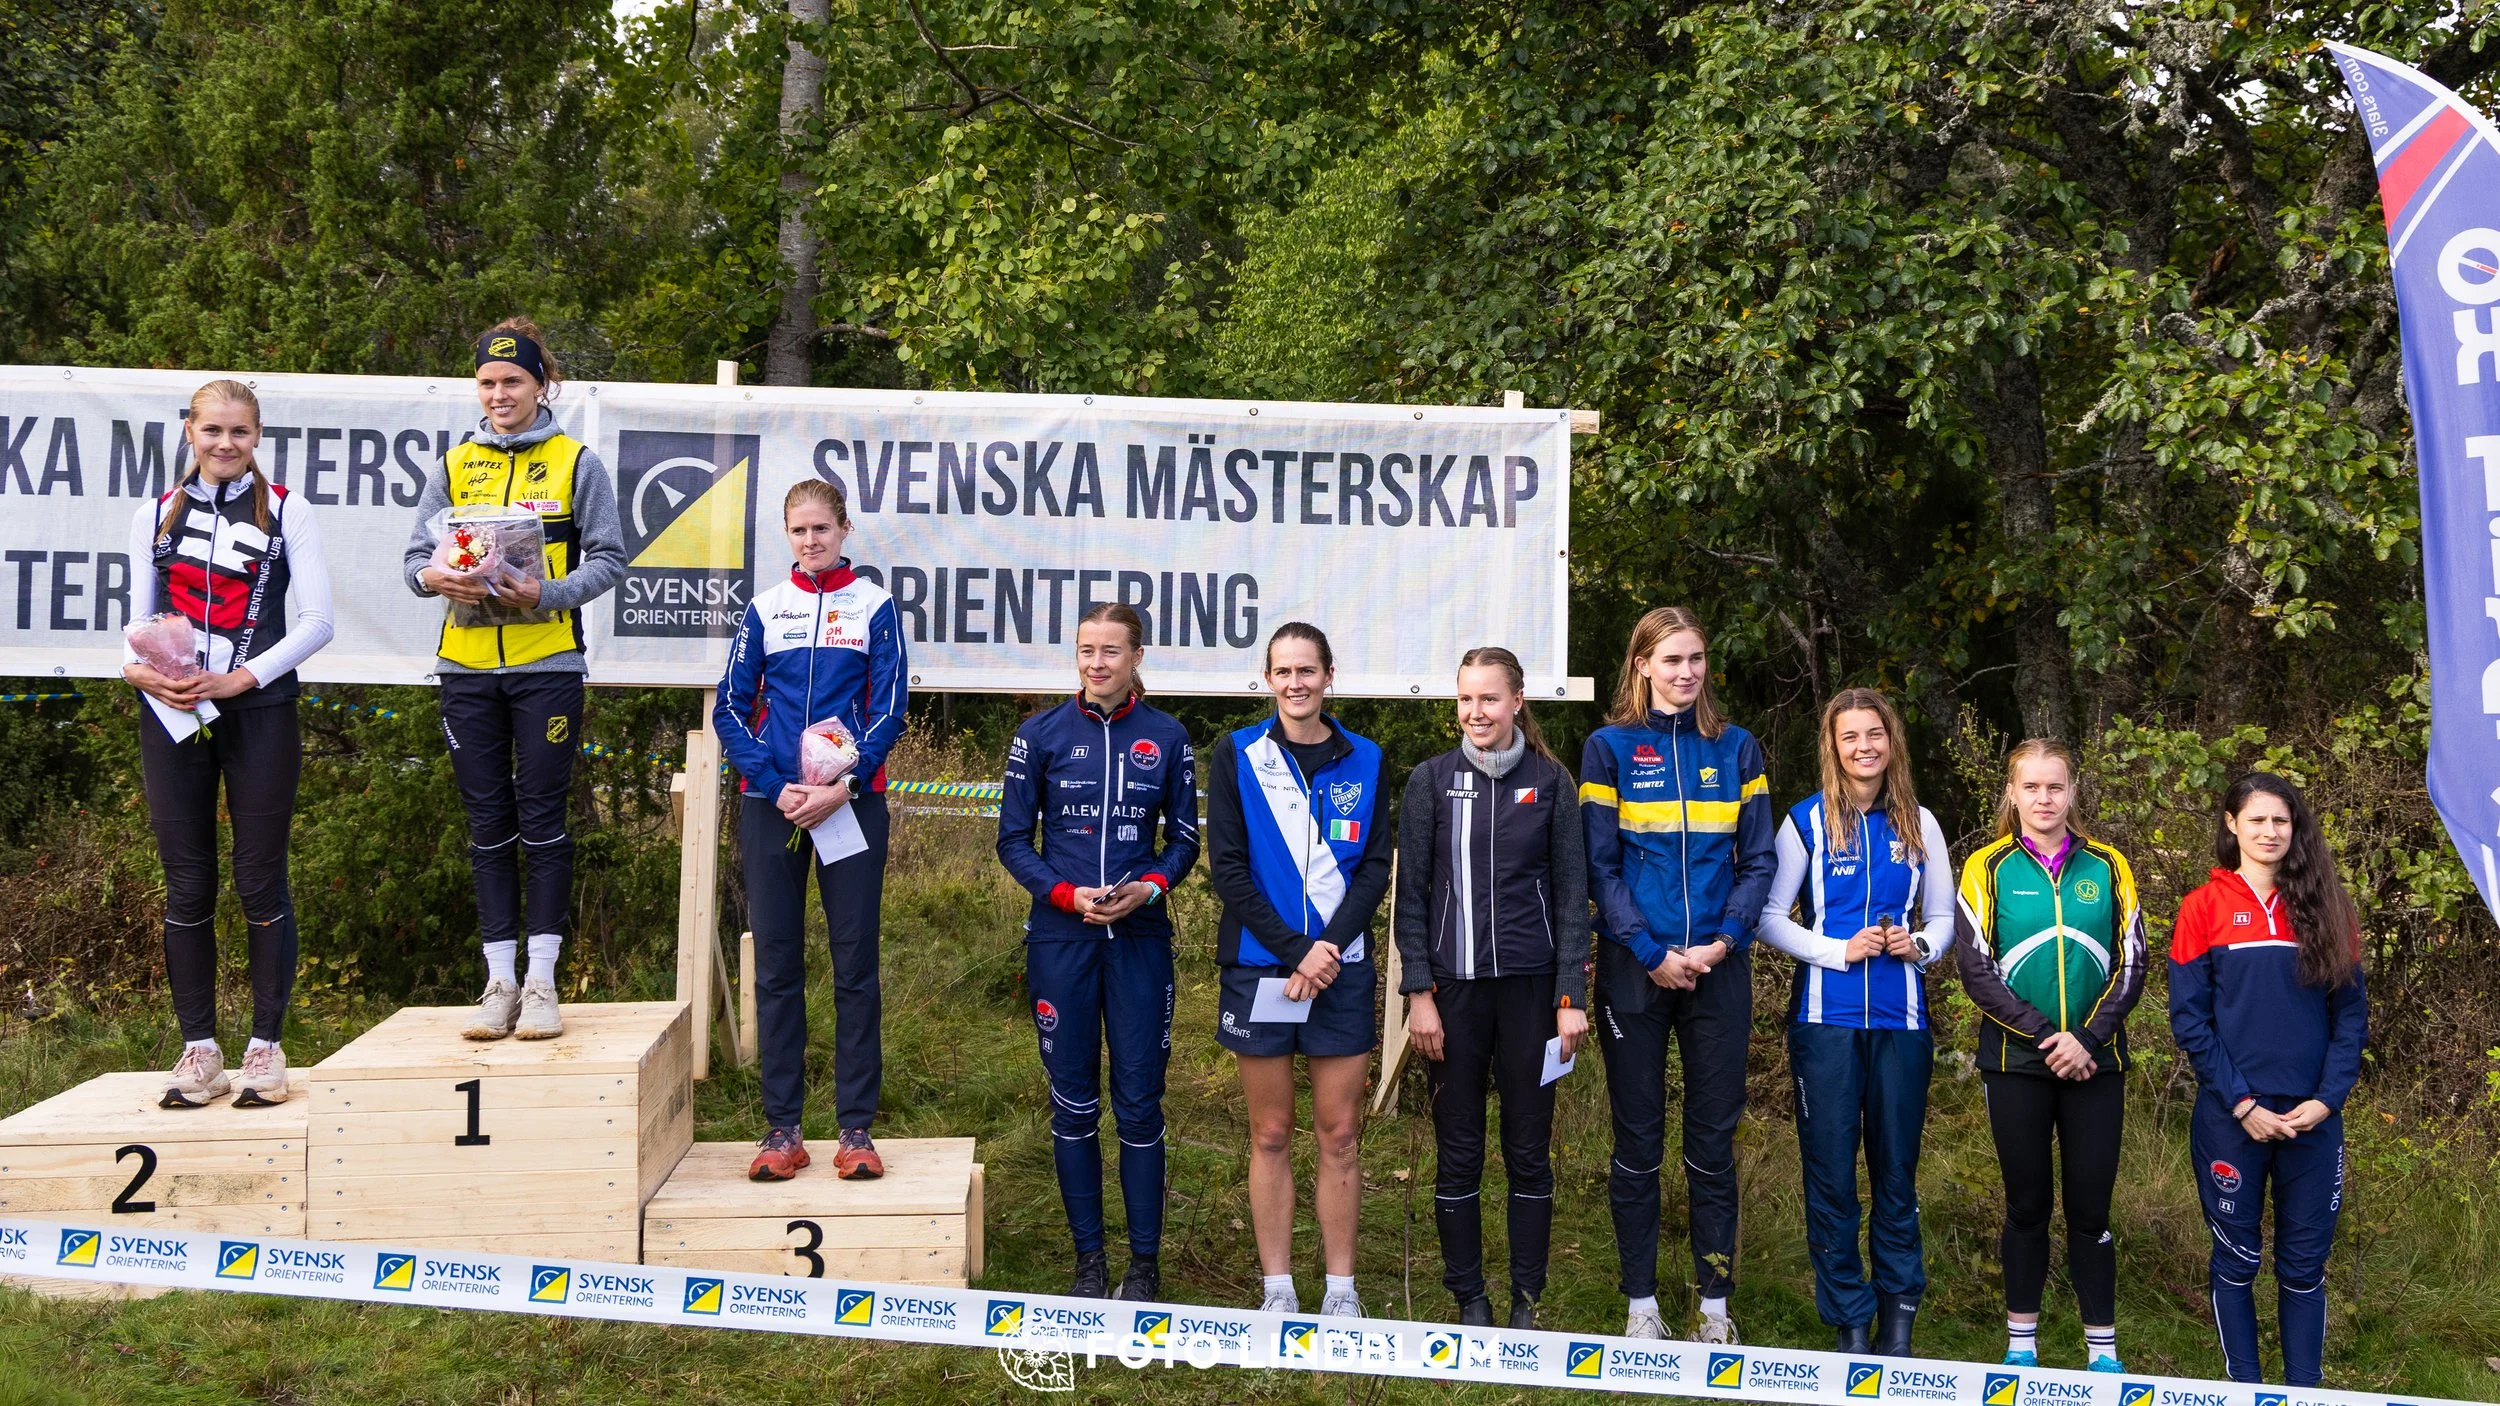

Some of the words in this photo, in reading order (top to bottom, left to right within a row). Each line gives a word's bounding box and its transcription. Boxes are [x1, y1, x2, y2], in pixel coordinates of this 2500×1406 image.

[463, 460, 503, 470] TRIMTEX
[1126, 433, 1539, 529] MÄSTERSKAP
[521, 489, 549, 500] viati
[155, 546, 171, 555] SCA
[624, 576, 744, 606] SVENSK
[622, 608, 744, 627] ORIENTERING
[826, 626, 842, 636] OK
[737, 624, 750, 664] TRIMTEX
[825, 637, 864, 647] Tisaren
[442, 717, 461, 751] TRIMTEX
[1636, 744, 1657, 756] ICA
[1446, 789, 1480, 799] TRIMTEX
[1632, 780, 1665, 789] TRIMTEX
[1222, 1011, 1235, 1026] GB
[1605, 1005, 1624, 1040] TRIMTEX
[1161, 1030, 1171, 1049] OK
[1221, 1021, 1251, 1039] STUDENTS
[454, 1078, 491, 1146] 1
[111, 1144, 158, 1214] 2
[2330, 1189, 2341, 1212] OK
[109, 1235, 188, 1258] SVENSK
[784, 1219, 825, 1278] 3
[106, 1255, 187, 1272] ORIENTERING
[268, 1248, 345, 1270] SVENSK
[264, 1267, 344, 1284] ORIENTERING
[424, 1260, 502, 1282] SVENSK
[421, 1278, 500, 1296] ORIENTERING
[578, 1273, 655, 1294] SVENSK
[576, 1291, 654, 1308] ORIENTERING
[732, 1285, 807, 1305] SVENSK
[729, 1303, 806, 1319] ORIENTERING
[883, 1296, 957, 1316] SVENSK
[880, 1314, 956, 1330] ORIENTERING
[1032, 1307, 1106, 1328] SVENSK
[1179, 1318, 1252, 1339] SVENSK
[1610, 1350, 1682, 1369] SVENSK
[1609, 1366, 1680, 1382] ORIENTERING
[1750, 1360, 1820, 1380] SVENSK
[1889, 1370, 1958, 1389] SVENSK
[1748, 1377, 1819, 1392] ORIENTERING
[1887, 1386, 1957, 1401] ORIENTERING
[2025, 1381, 2094, 1400] SVENSK
